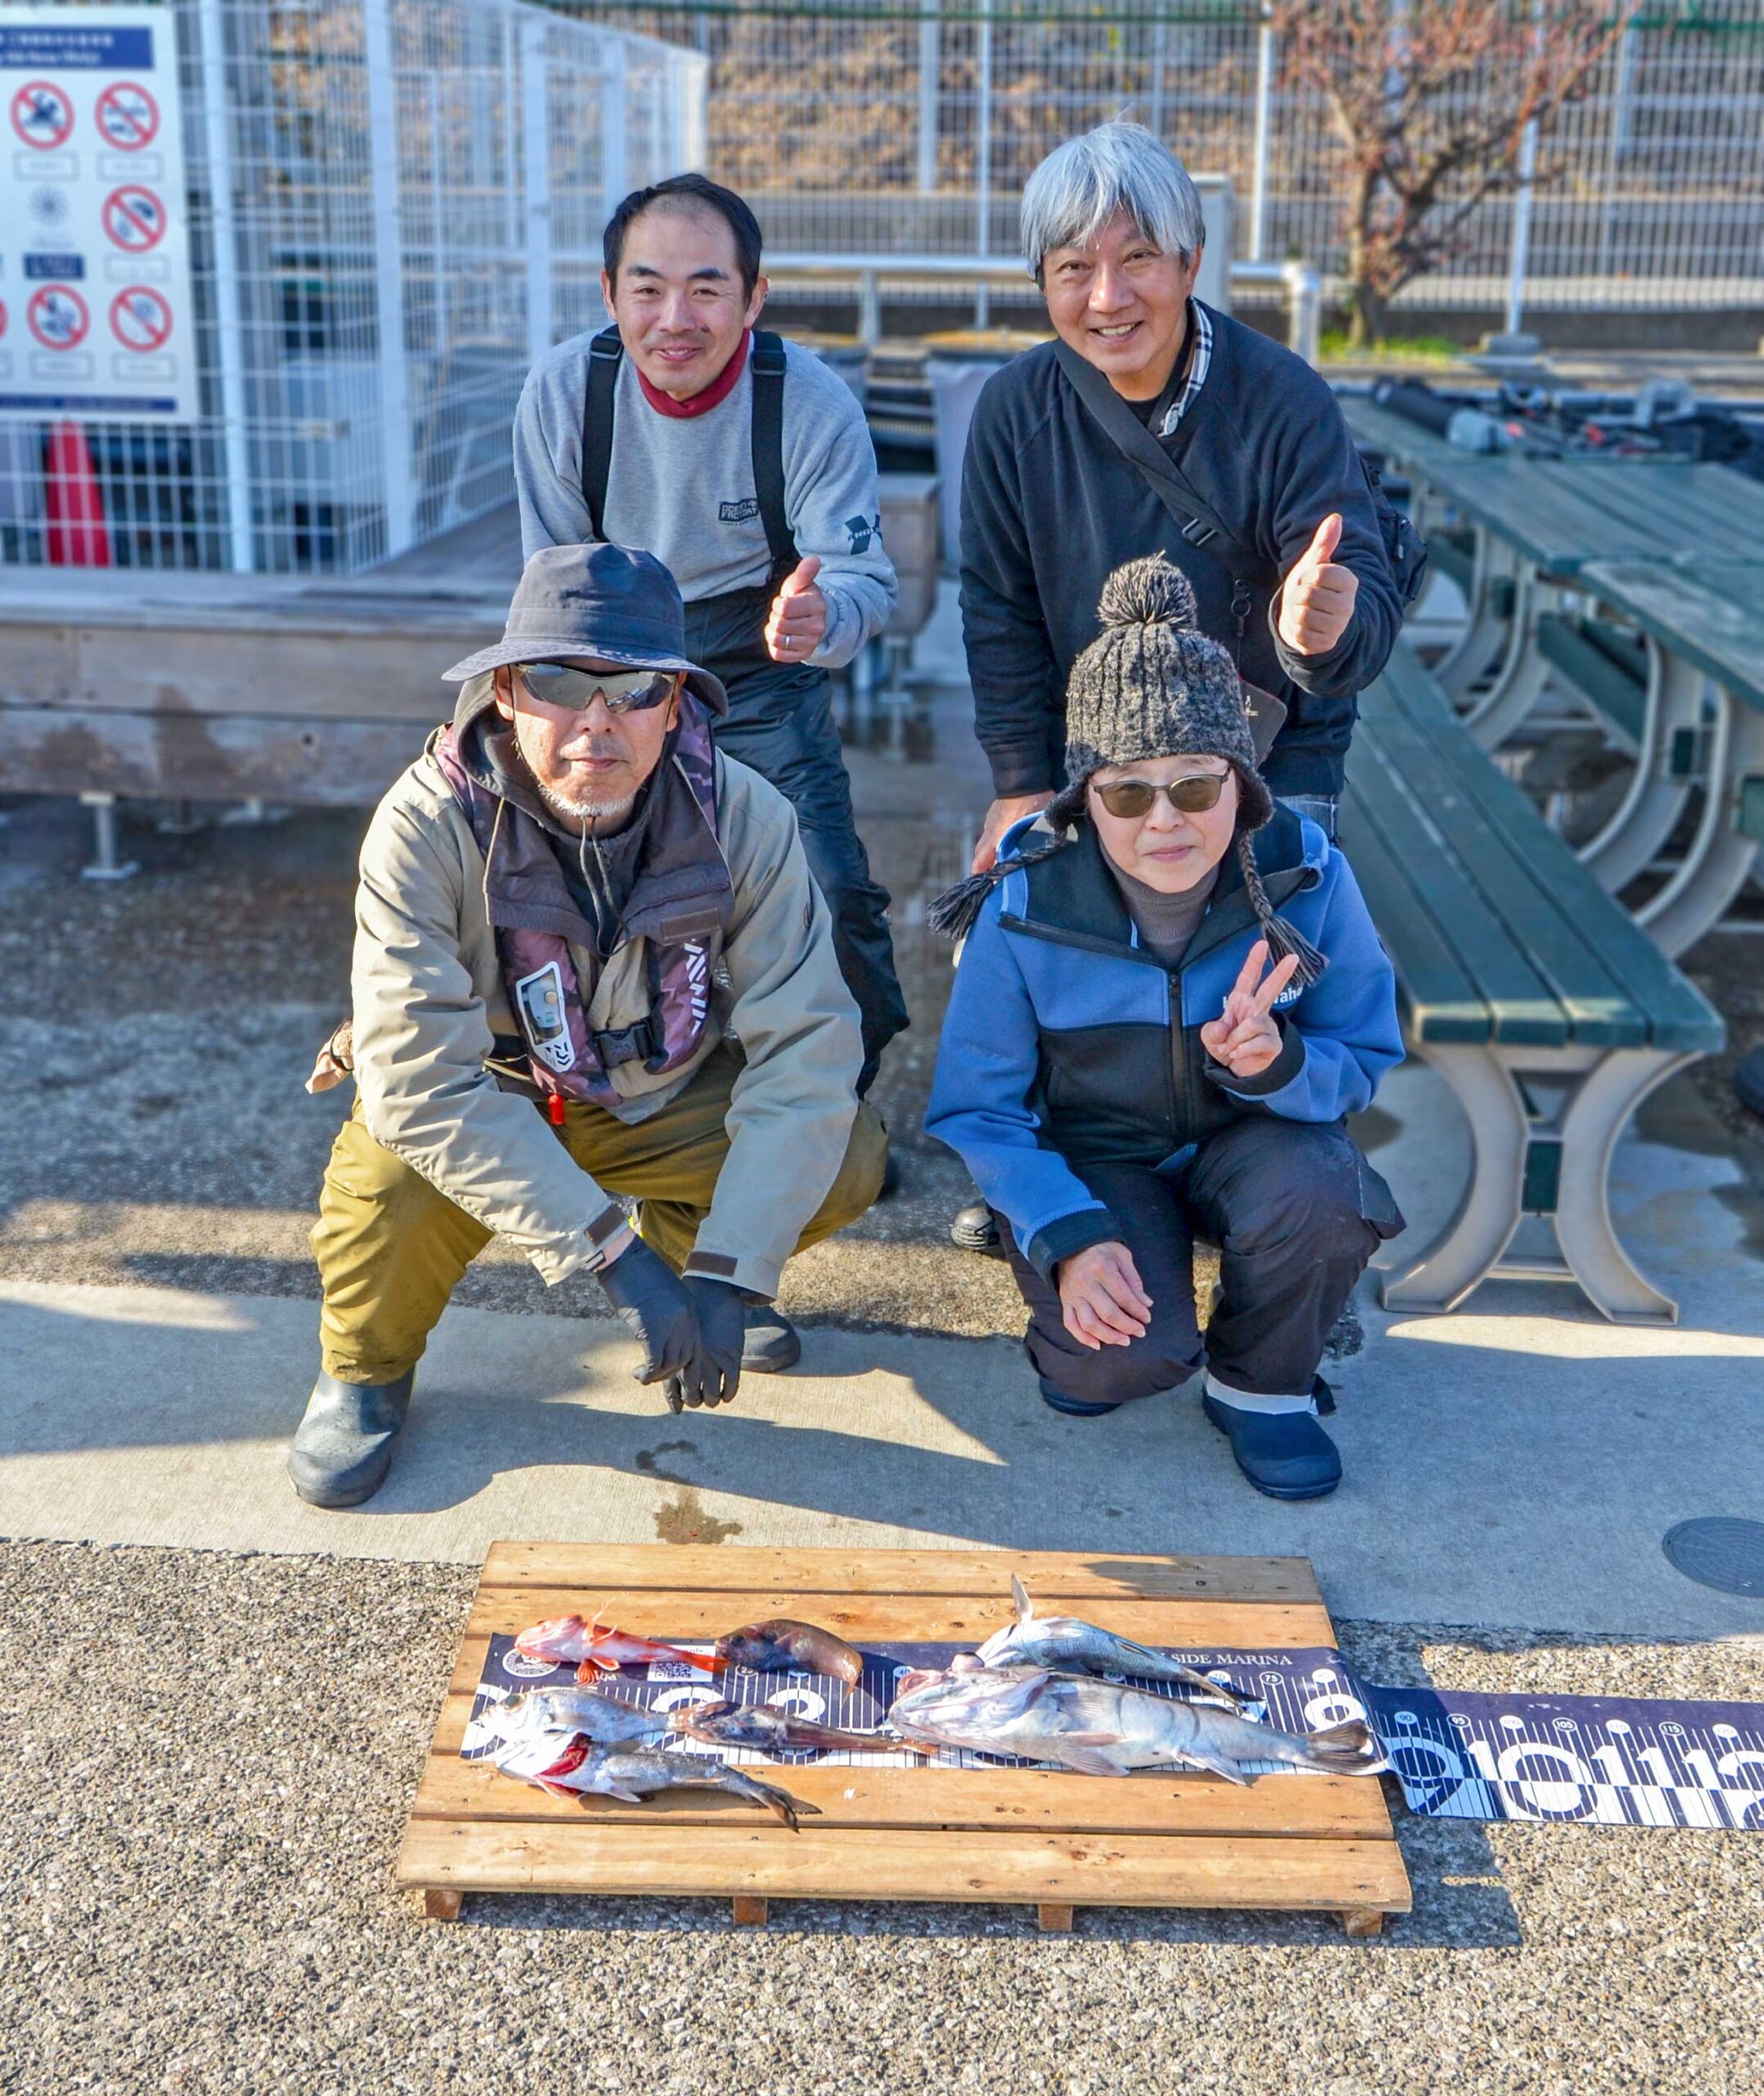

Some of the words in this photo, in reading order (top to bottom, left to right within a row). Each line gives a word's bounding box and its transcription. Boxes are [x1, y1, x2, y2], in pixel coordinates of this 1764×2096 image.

[1171, 1653, 1211, 1665] SIDE
[1216, 1653, 1293, 1665] MARINA
[1265, 1674, 1278, 1683] 75
[1451, 1716, 1466, 1725] 95
[1556, 1720, 1574, 1729] 105
[1662, 1724, 1679, 1733] 115
